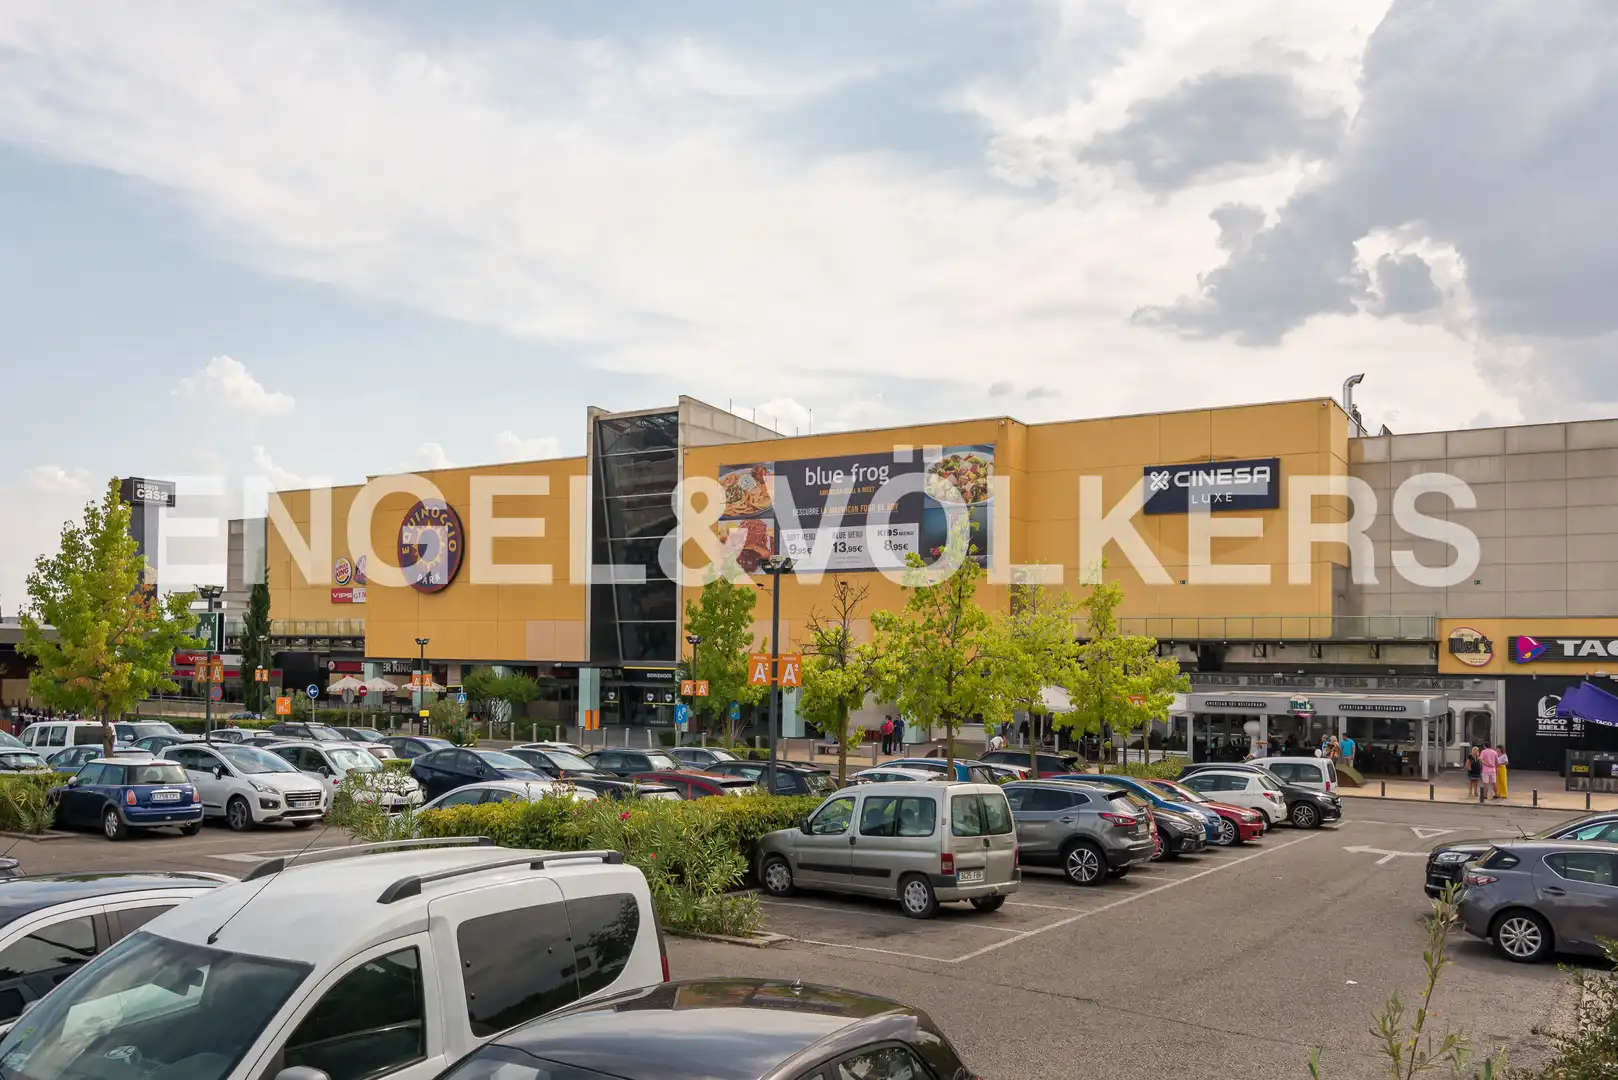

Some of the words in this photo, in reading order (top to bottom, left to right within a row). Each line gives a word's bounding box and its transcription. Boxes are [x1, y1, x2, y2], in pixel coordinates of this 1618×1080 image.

[805, 466, 844, 486] blue
[851, 463, 890, 485] frog
[1173, 466, 1271, 487] CINESA
[137, 489, 168, 501] casa
[1192, 492, 1233, 504] LUXE
[792, 507, 820, 516] DESCUBRE
[828, 504, 859, 513] AMERICAN
[860, 503, 876, 512] FOOD
[402, 506, 457, 555] EQUINOCCIO
[832, 532, 847, 540] BLUE
[848, 530, 863, 539] MENU
[877, 528, 899, 537] KIDS
[803, 533, 816, 541] MENU
[789, 543, 812, 555] 9,95€
[833, 542, 863, 553] 13,95€
[884, 540, 909, 551] 8,95€
[336, 568, 349, 578] KING
[417, 572, 440, 584] PARK
[332, 592, 353, 600] VIPS
[1448, 636, 1493, 653] Mel's
[392, 662, 413, 673] KING
[1290, 700, 1314, 710] Mel's
[1595, 719, 1613, 727] TACO
